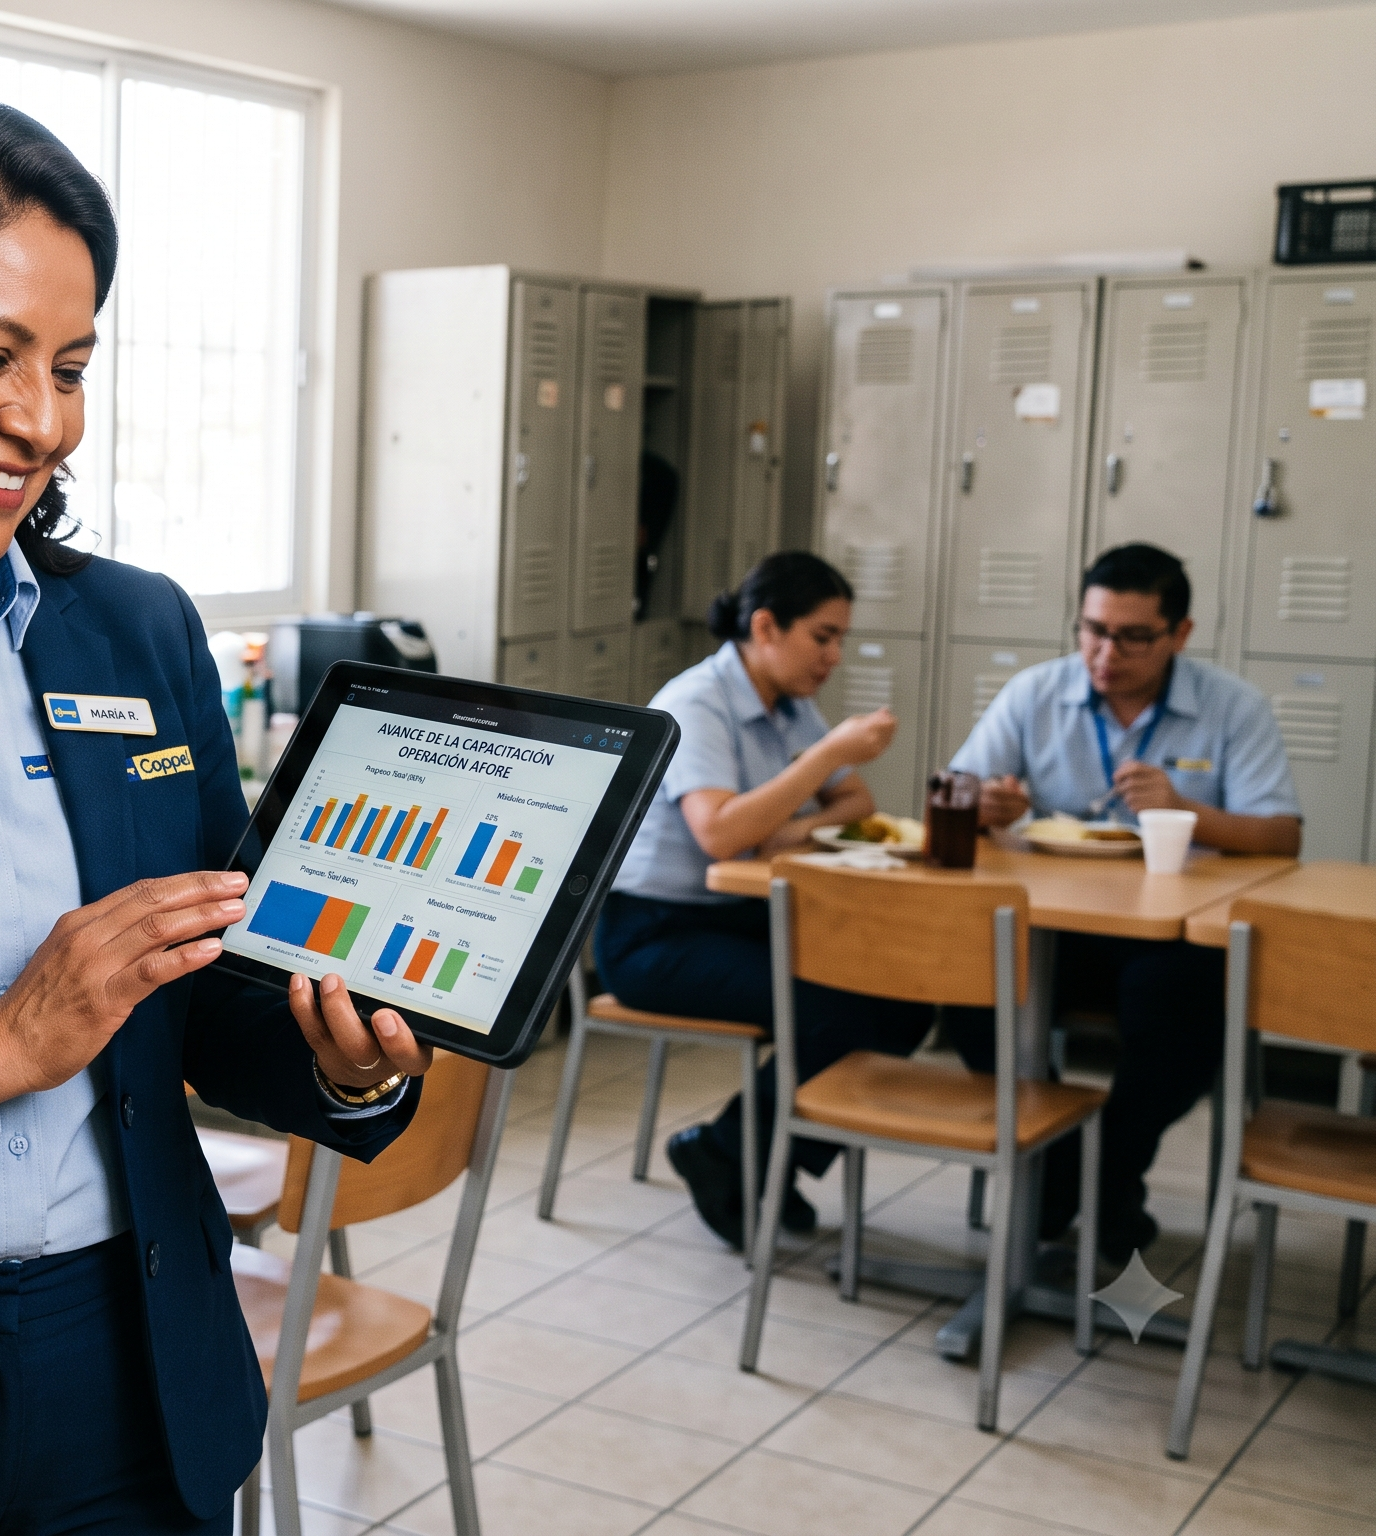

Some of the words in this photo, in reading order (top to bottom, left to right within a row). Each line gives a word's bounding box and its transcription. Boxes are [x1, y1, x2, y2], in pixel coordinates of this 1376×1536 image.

[90, 708, 126, 720] MARÍA
[128, 711, 139, 720] R.
[377, 722, 425, 741] AVANCE
[425, 731, 444, 745] DE
[444, 735, 459, 748] LA
[462, 738, 555, 766] CAPACITACIÓN
[140, 749, 191, 775] Coppel
[398, 746, 469, 770] OPERACIÓN
[469, 760, 513, 779] AFORE
